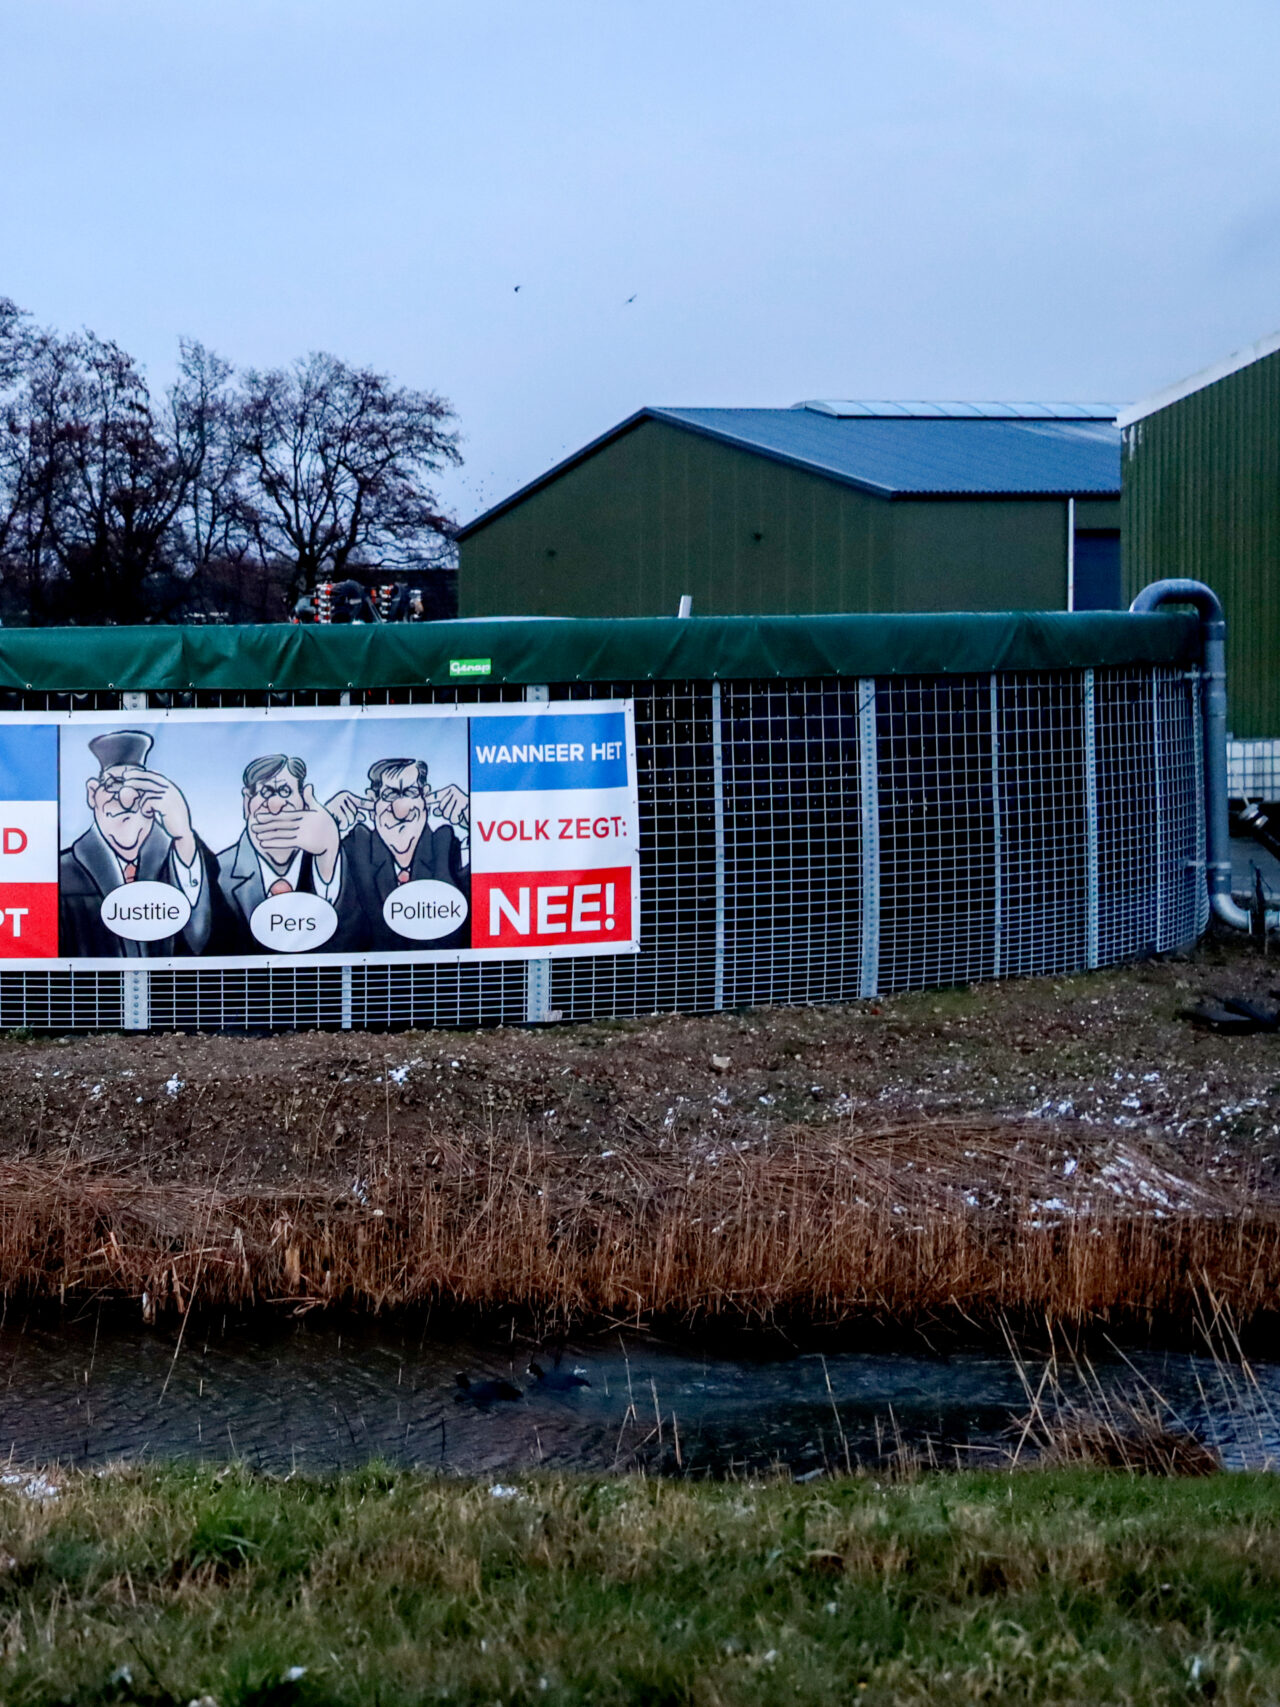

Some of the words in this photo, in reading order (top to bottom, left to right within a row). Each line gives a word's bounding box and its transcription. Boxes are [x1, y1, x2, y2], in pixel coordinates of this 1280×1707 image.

[475, 743, 585, 764] WANNEER
[591, 741, 623, 761] HET
[477, 818, 550, 842] VOLK
[558, 816, 628, 840] ZEGT:
[107, 902, 180, 921] Justitie
[390, 900, 462, 922] Politiek
[489, 883, 616, 937] NEE!
[270, 913, 316, 932] Pers
